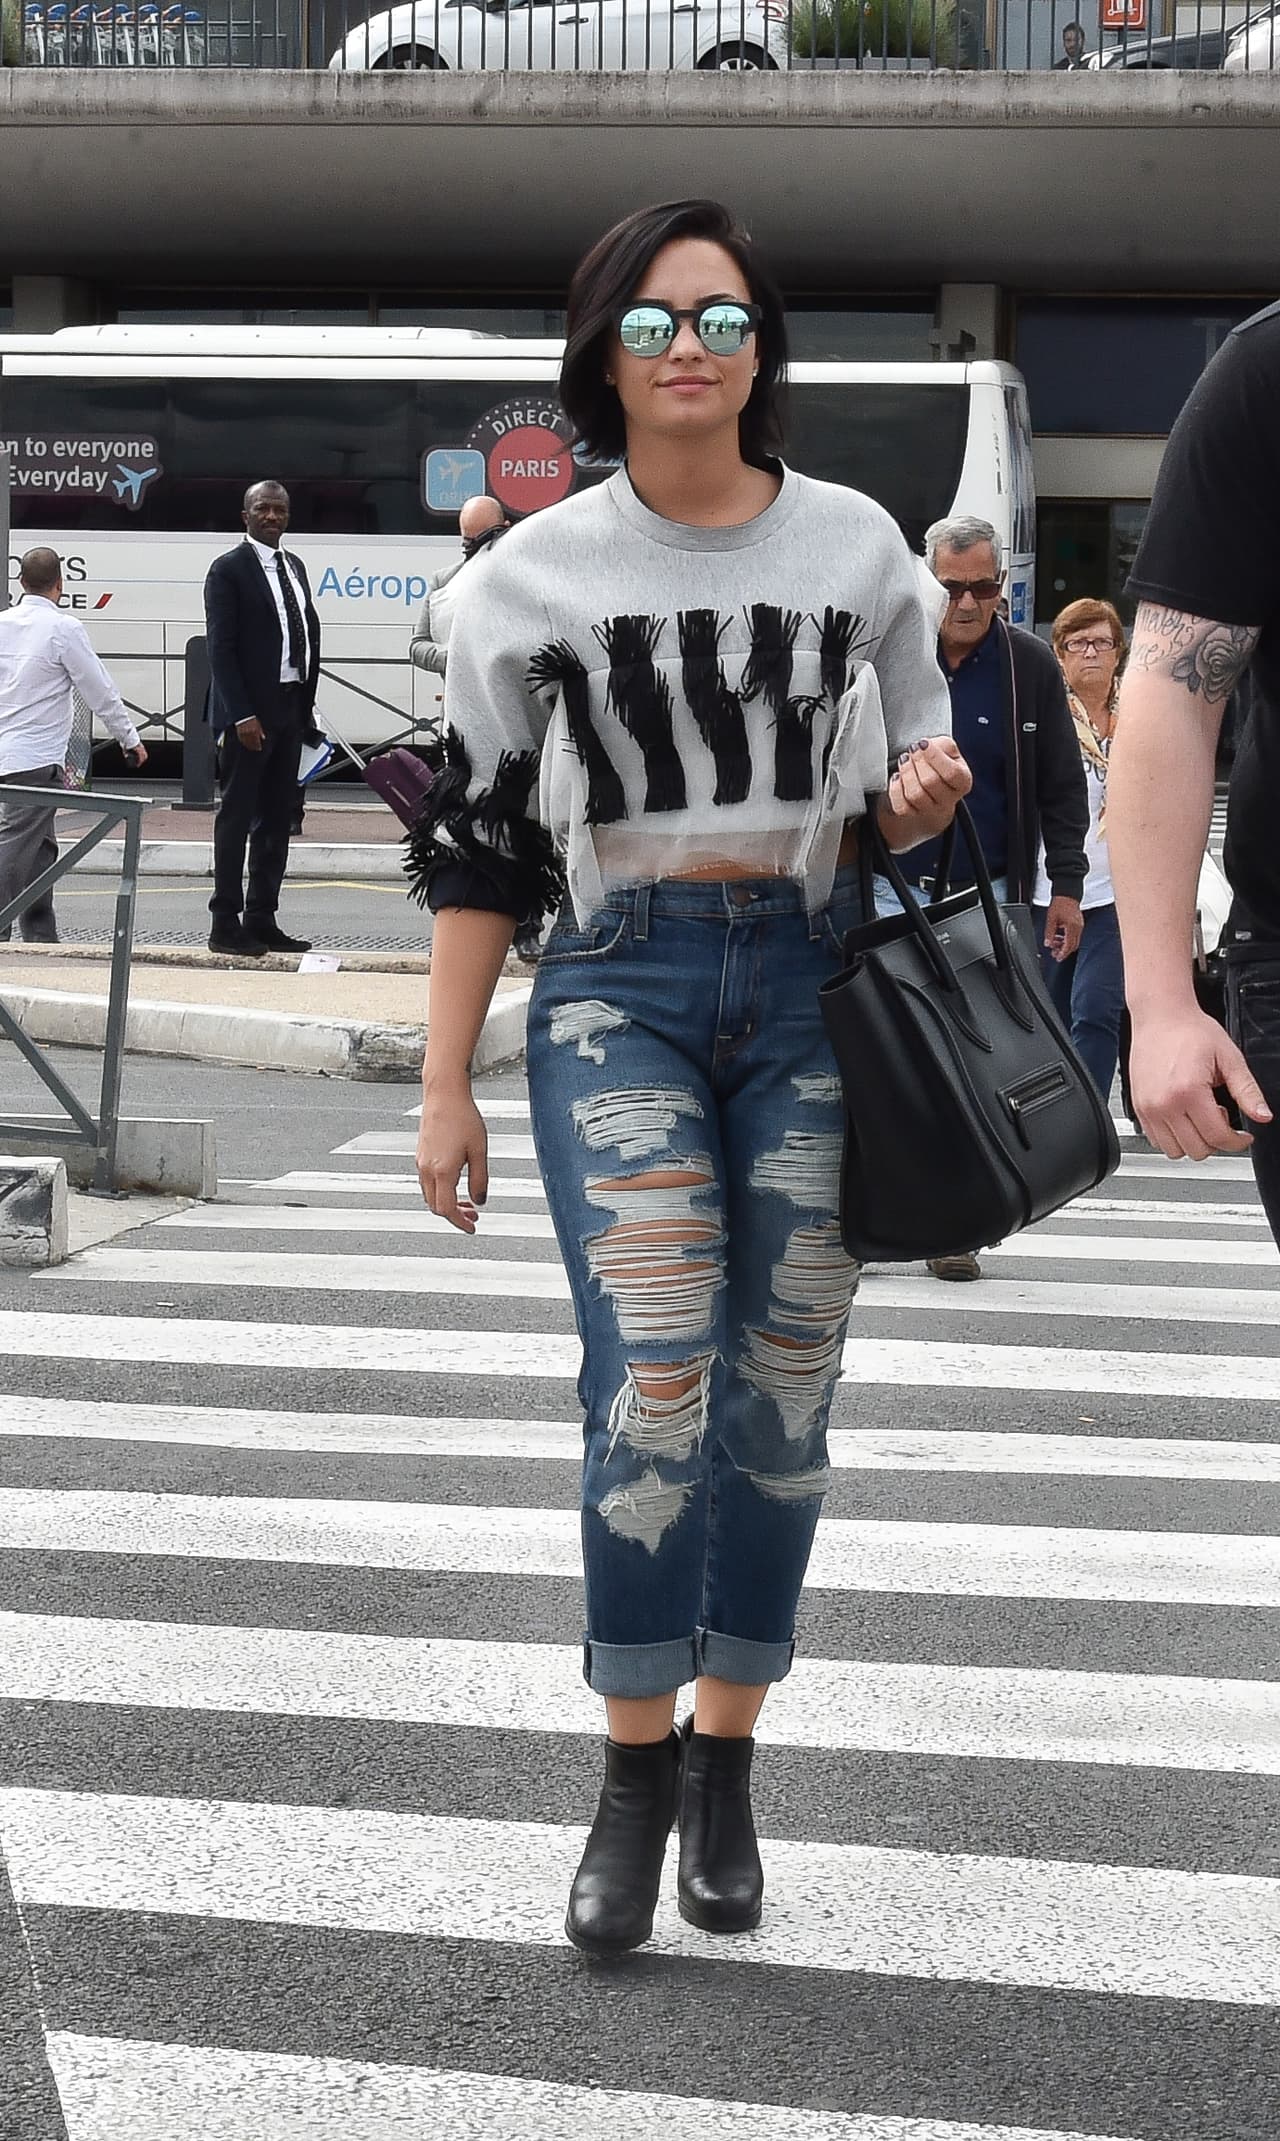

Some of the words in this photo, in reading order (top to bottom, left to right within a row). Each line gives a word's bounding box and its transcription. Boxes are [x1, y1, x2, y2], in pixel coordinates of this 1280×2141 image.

[491, 409, 562, 435] DIRECT
[25, 437, 47, 457] to
[53, 440, 154, 463] everyone
[9, 465, 109, 493] Everyday
[501, 459, 560, 478] PARIS
[317, 566, 427, 606] Aérop
